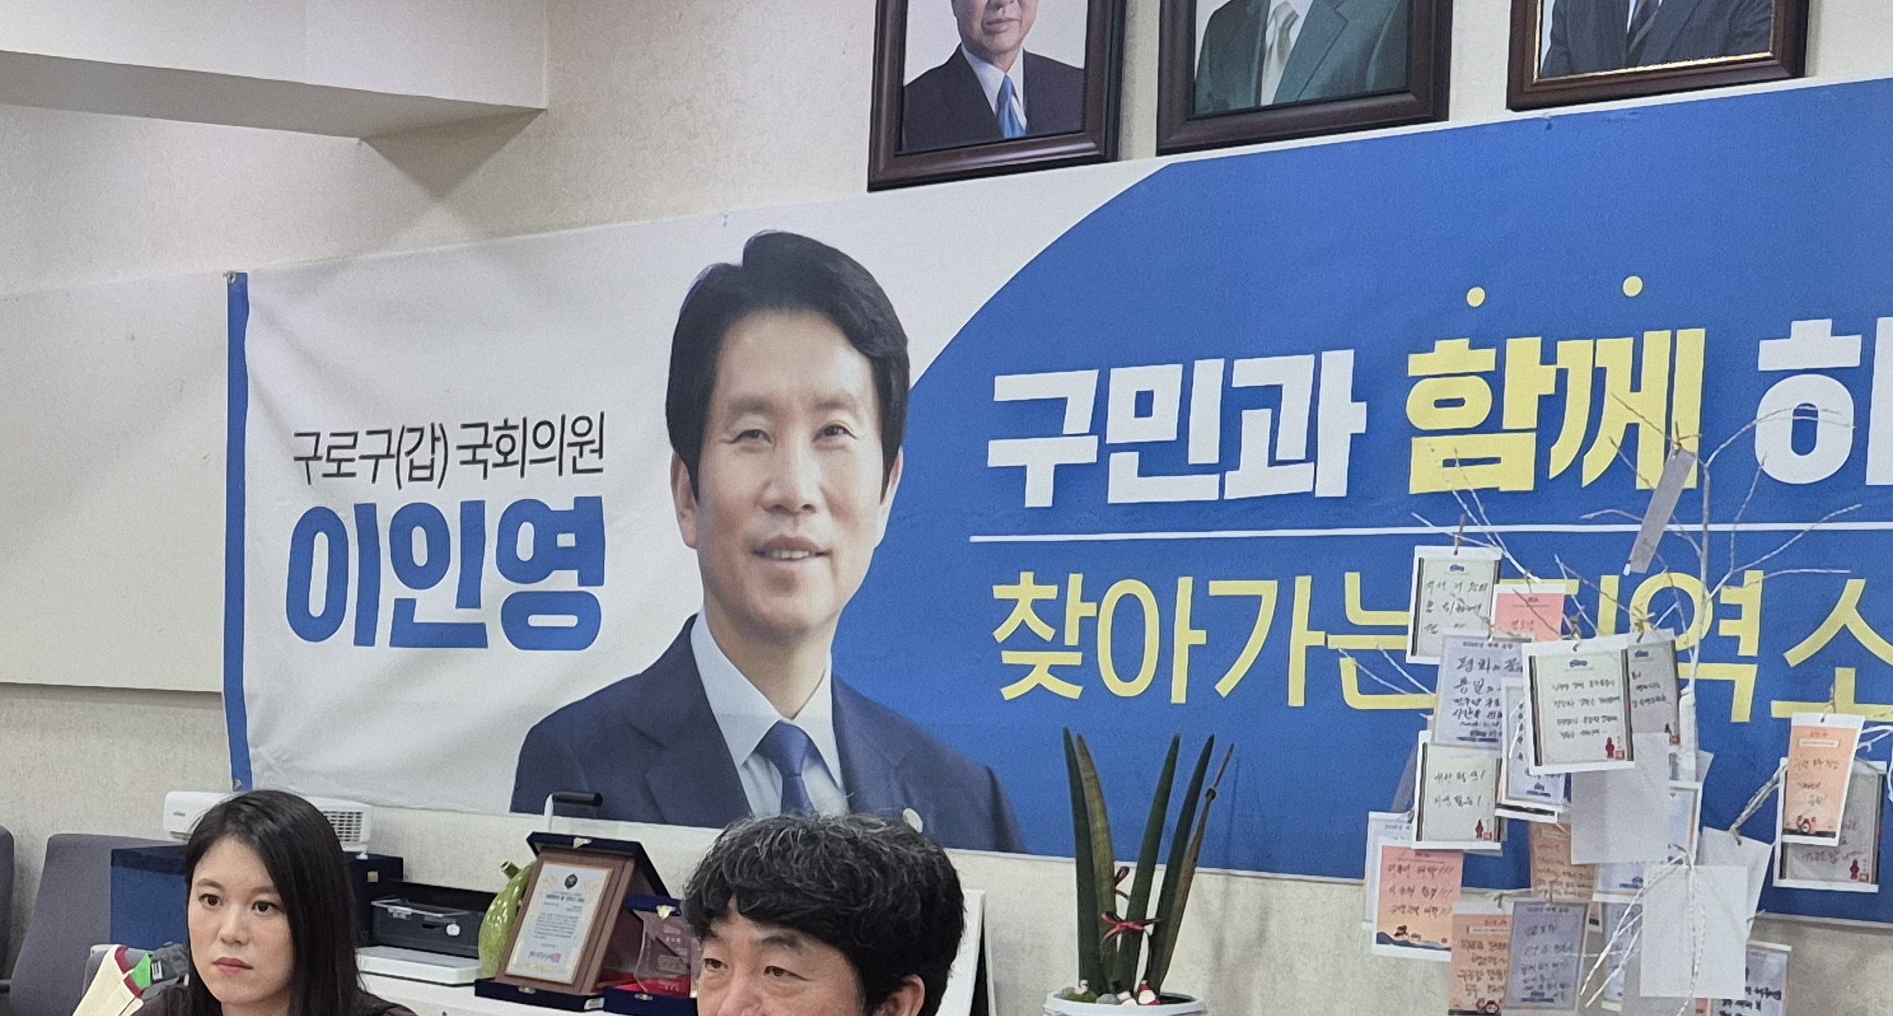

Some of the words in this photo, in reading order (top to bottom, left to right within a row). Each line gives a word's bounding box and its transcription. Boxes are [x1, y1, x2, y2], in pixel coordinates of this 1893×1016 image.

[292, 423, 449, 490] 구로구(갑)
[456, 411, 605, 480] 국회의원
[987, 349, 1367, 508] 구민과
[1405, 327, 1706, 495] 함께
[1755, 317, 1893, 486] 하
[285, 495, 606, 651] 이인영
[992, 571, 1438, 711] 찾아가는
